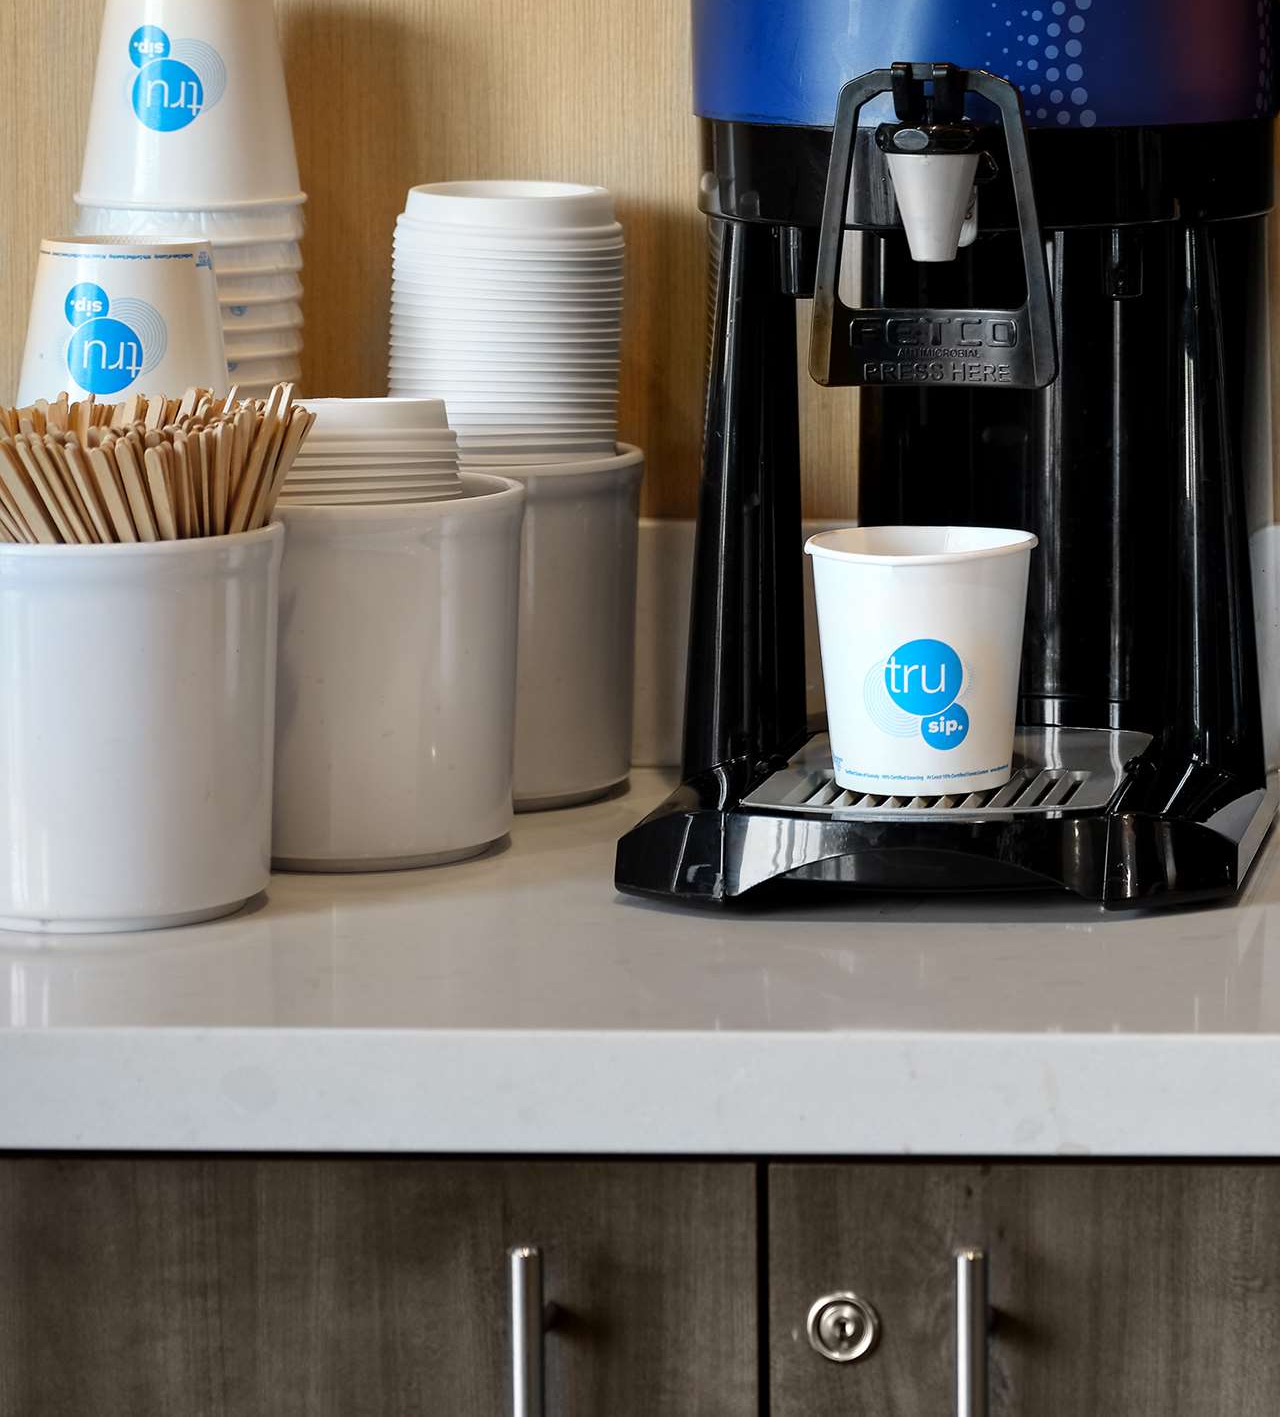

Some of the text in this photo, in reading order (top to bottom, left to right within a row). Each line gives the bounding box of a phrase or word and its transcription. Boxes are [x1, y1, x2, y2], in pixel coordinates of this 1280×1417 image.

[146, 80, 202, 116] tru
[850, 318, 1018, 348] FETCO
[83, 340, 141, 377] tru
[897, 348, 980, 358] ANTIMICROBIAL
[864, 362, 1011, 382] PRESS HERE
[883, 656, 945, 694] tru
[928, 716, 963, 735] sip.
